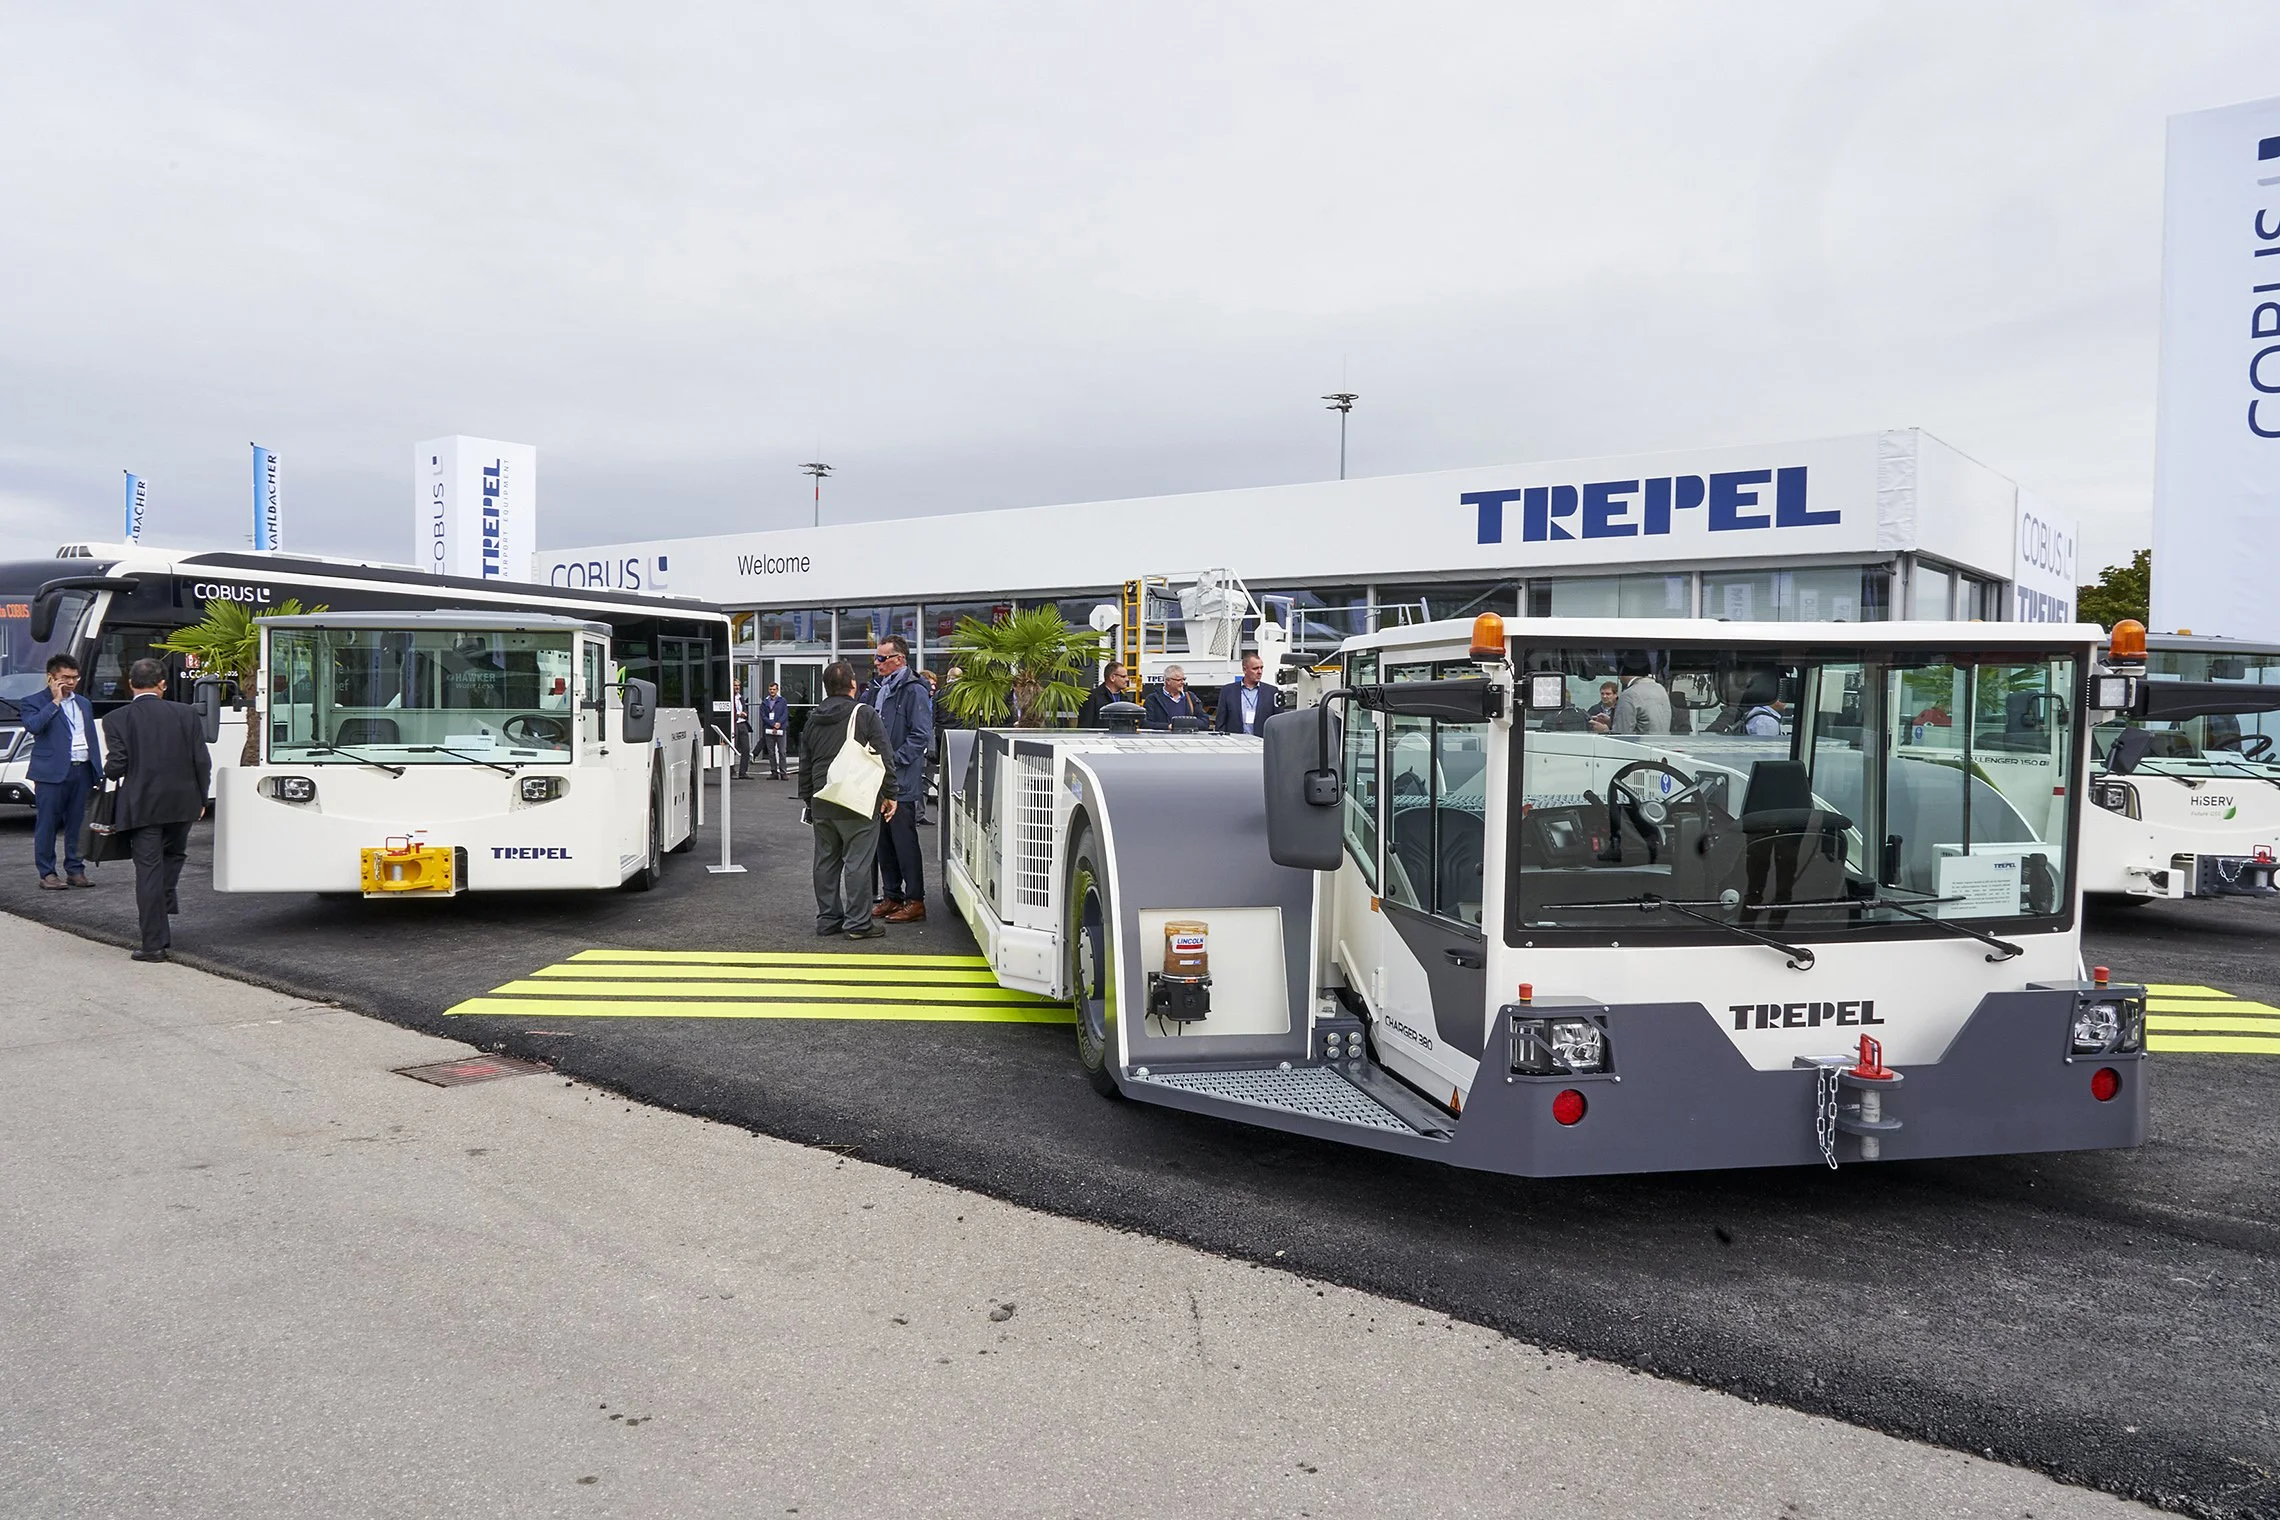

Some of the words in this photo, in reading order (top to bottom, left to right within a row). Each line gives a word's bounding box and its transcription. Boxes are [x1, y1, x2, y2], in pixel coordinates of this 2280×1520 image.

[132, 480, 146, 544] LBACHER
[482, 458, 500, 579] TREPEL
[1460, 466, 1840, 545] TREPEL
[433, 482, 445, 575] COBUS
[2022, 512, 2062, 577] COBUS
[551, 558, 641, 590] COBUS
[737, 553, 810, 575] Welcome
[194, 583, 255, 602] COBUS
[455, 673, 495, 682] HAWKER
[1147, 675, 1166, 683] TRE
[1954, 755, 2018, 764] CLLENGER
[2190, 796, 2234, 806] HiSERV
[491, 847, 572, 859] TREPEL
[1729, 1001, 1885, 1030] TREPEL
[1385, 1015, 1418, 1041] CHARGER
[1418, 1034, 1433, 1051] 380
